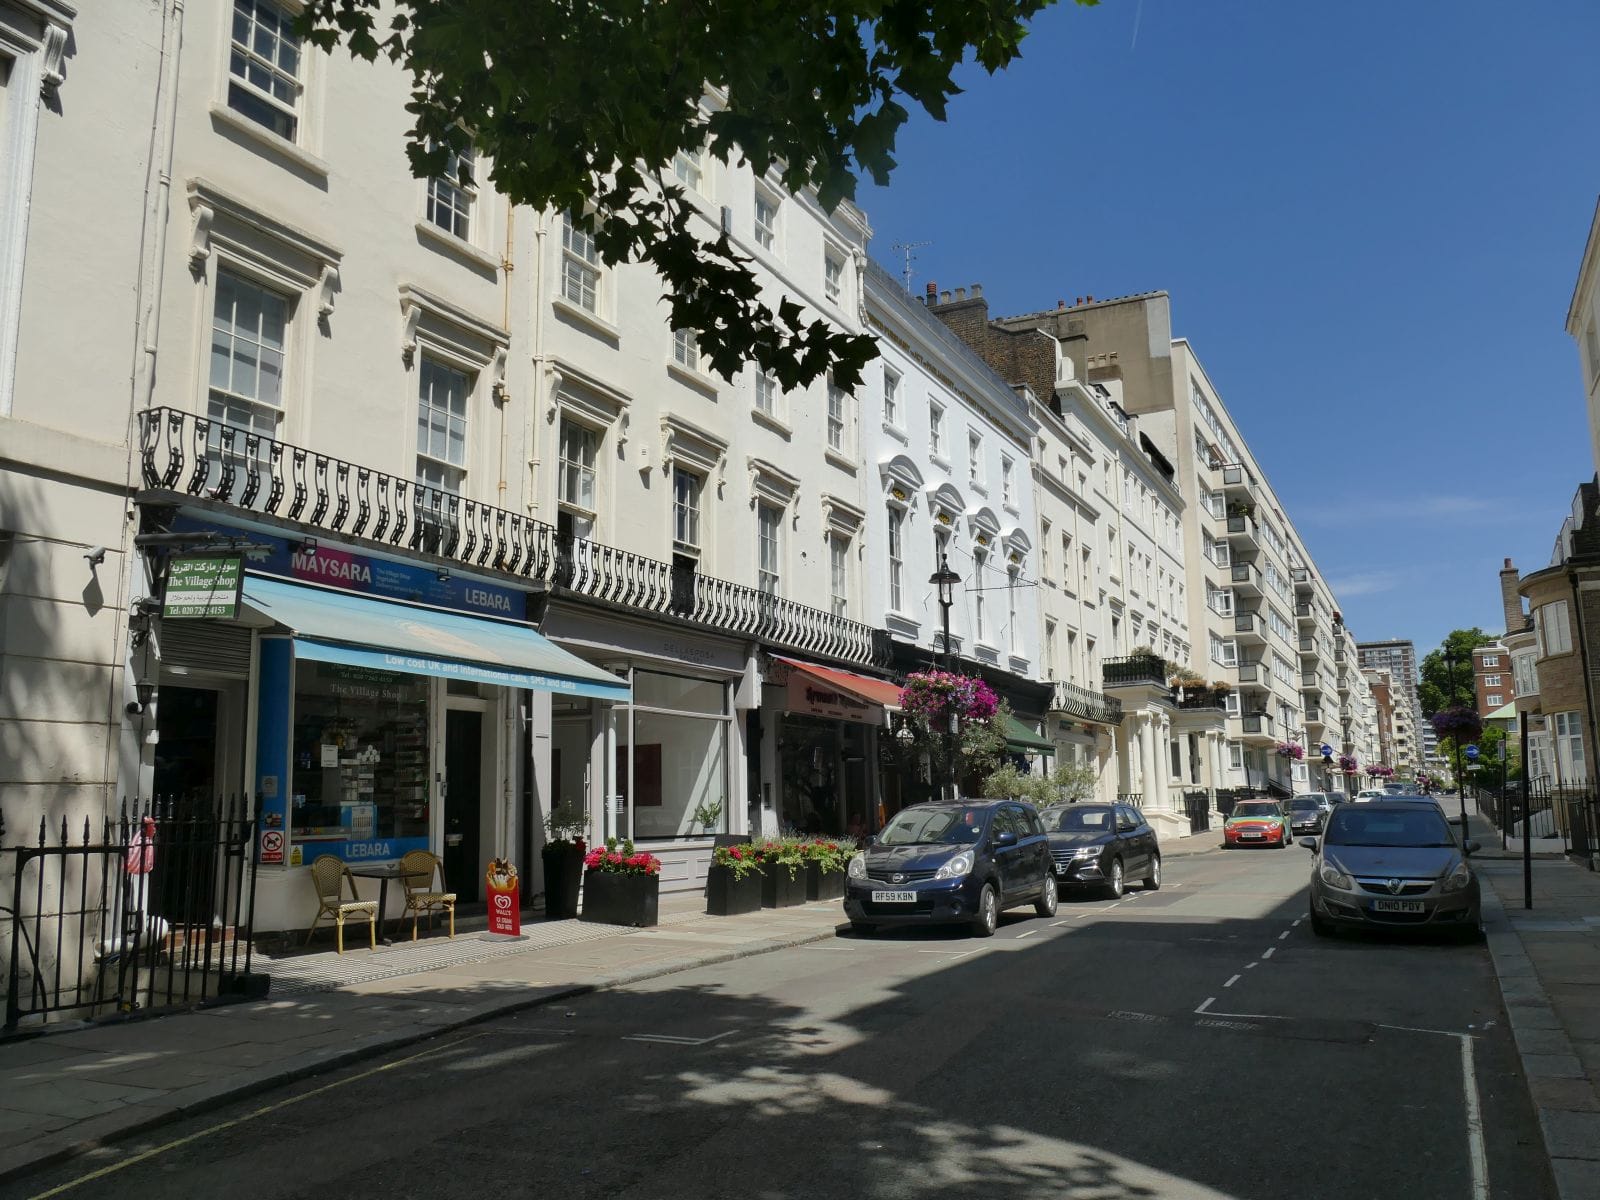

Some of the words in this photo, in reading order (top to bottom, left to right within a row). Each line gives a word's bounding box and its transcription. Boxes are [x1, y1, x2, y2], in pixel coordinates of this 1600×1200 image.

[291, 552, 372, 584] MAYSARA
[168, 576, 183, 587] The
[185, 575, 213, 589] Village
[465, 587, 511, 612] LEBARA
[182, 606, 194, 614] 020
[211, 606, 225, 614] 4153
[385, 655, 404, 665] Low
[407, 658, 426, 669] cost
[428, 660, 441, 671] UK
[442, 663, 459, 673] and
[530, 675, 545, 685] SMS
[345, 842, 391, 858] LEBARA
[875, 892, 896, 901] RF59
[897, 892, 913, 901] KBN
